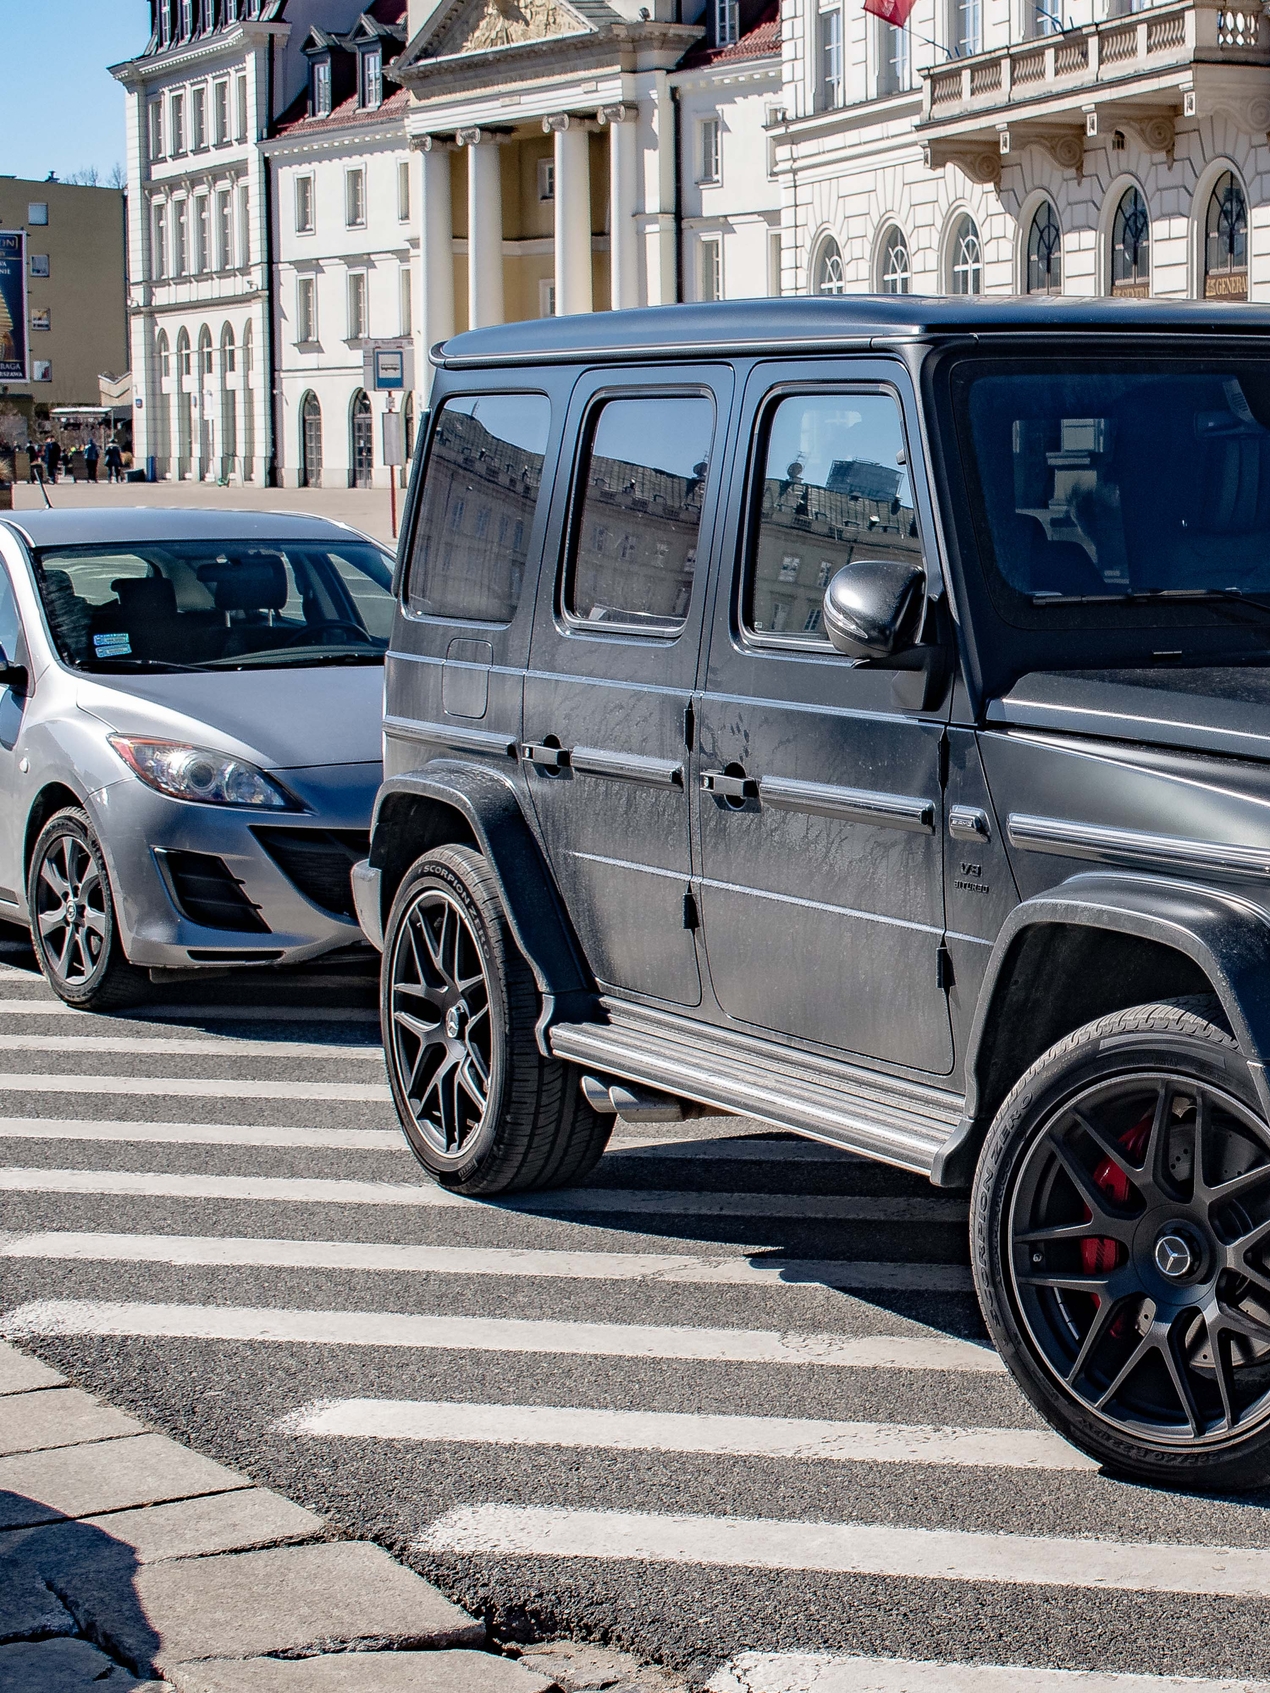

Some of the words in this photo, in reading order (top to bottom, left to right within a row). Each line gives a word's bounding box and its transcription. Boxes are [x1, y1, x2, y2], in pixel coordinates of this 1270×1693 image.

[424, 865, 471, 905] SCORPION
[960, 862, 982, 878] V8
[468, 905, 490, 959] ZERO
[978, 1168, 1000, 1327] SCORPION
[991, 1091, 1033, 1164] ZERO
